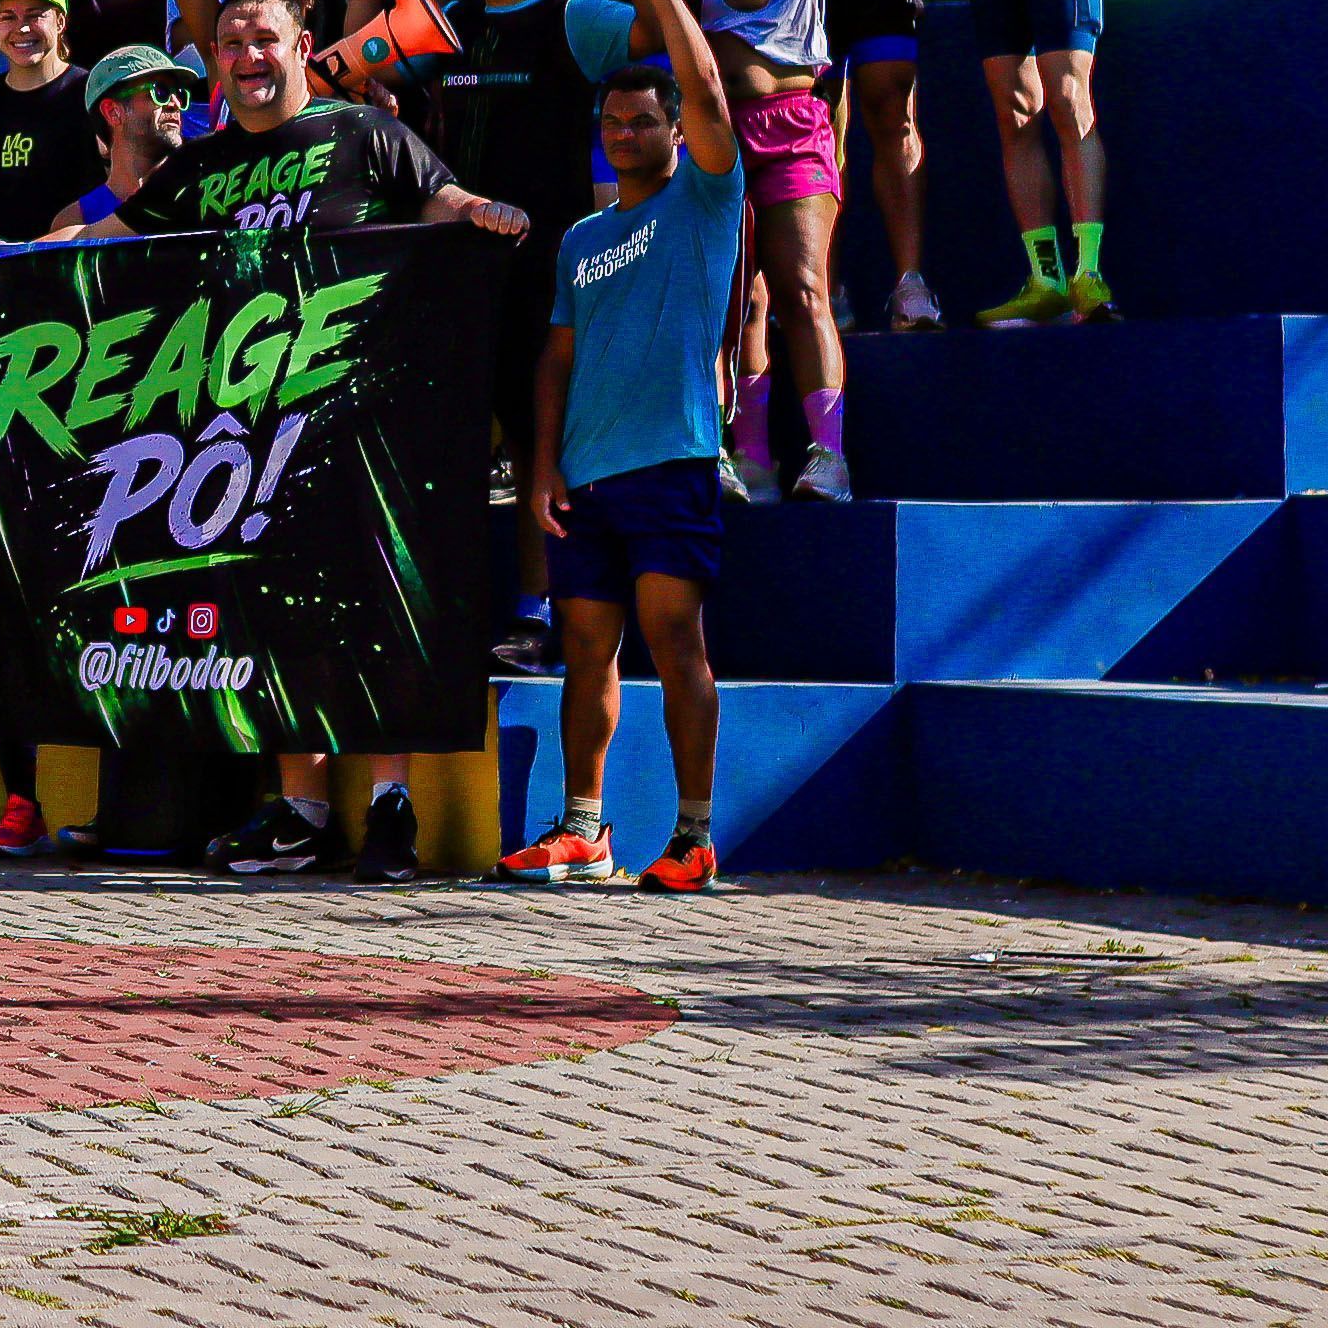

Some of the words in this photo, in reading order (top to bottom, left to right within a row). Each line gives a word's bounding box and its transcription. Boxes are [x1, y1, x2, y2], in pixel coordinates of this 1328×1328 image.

[447, 74, 478, 86] SICOOB
[1, 151, 29, 168] BH
[2, 132, 33, 153] MO
[198, 142, 337, 221] REAGE
[79, 411, 309, 582] PÔ!
[78, 640, 254, 692] @filbodao
